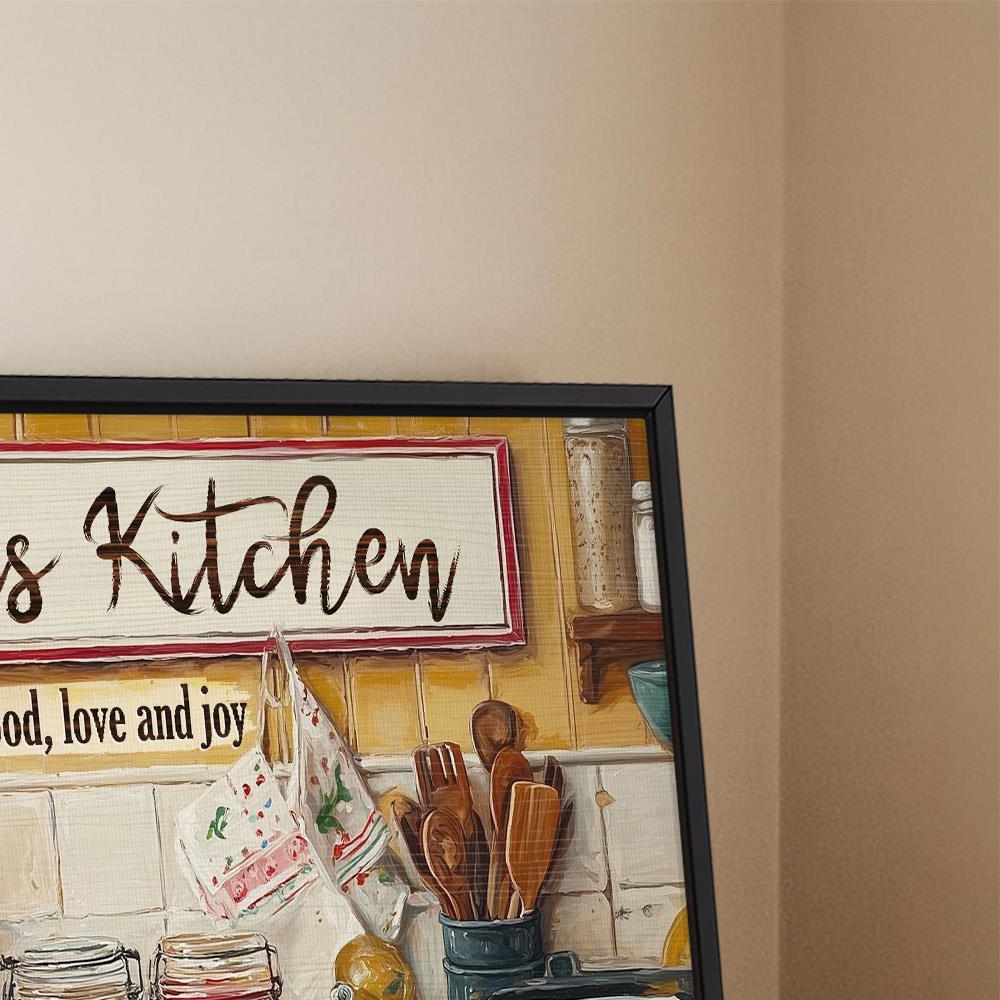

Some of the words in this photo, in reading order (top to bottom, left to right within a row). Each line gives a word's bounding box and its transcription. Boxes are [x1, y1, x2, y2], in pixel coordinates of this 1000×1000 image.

[82, 474, 461, 623] Kitchen
[58, 687, 127, 744] love
[136, 683, 194, 742] and
[200, 685, 248, 750] joy
